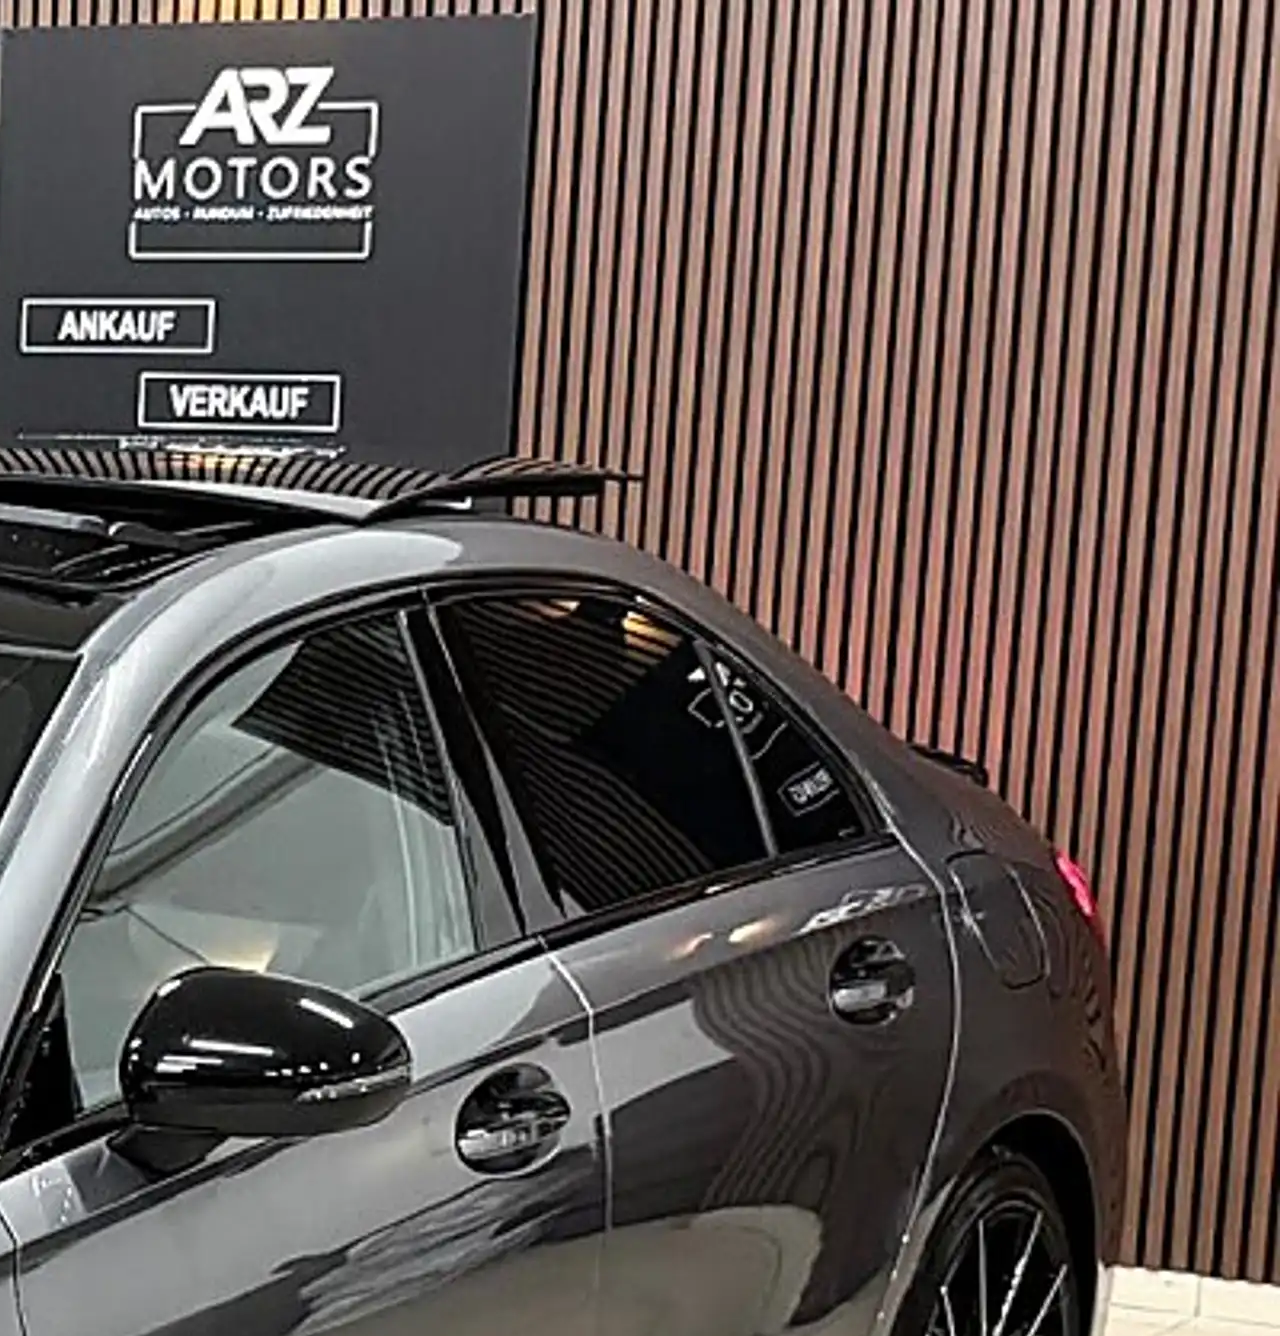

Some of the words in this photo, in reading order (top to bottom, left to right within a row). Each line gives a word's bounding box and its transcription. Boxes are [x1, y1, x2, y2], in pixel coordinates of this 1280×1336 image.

[179, 67, 335, 145] ARZ
[135, 156, 372, 200] MOTORS
[58, 310, 175, 342] ANKAUF
[169, 385, 309, 420] VERKAUF
